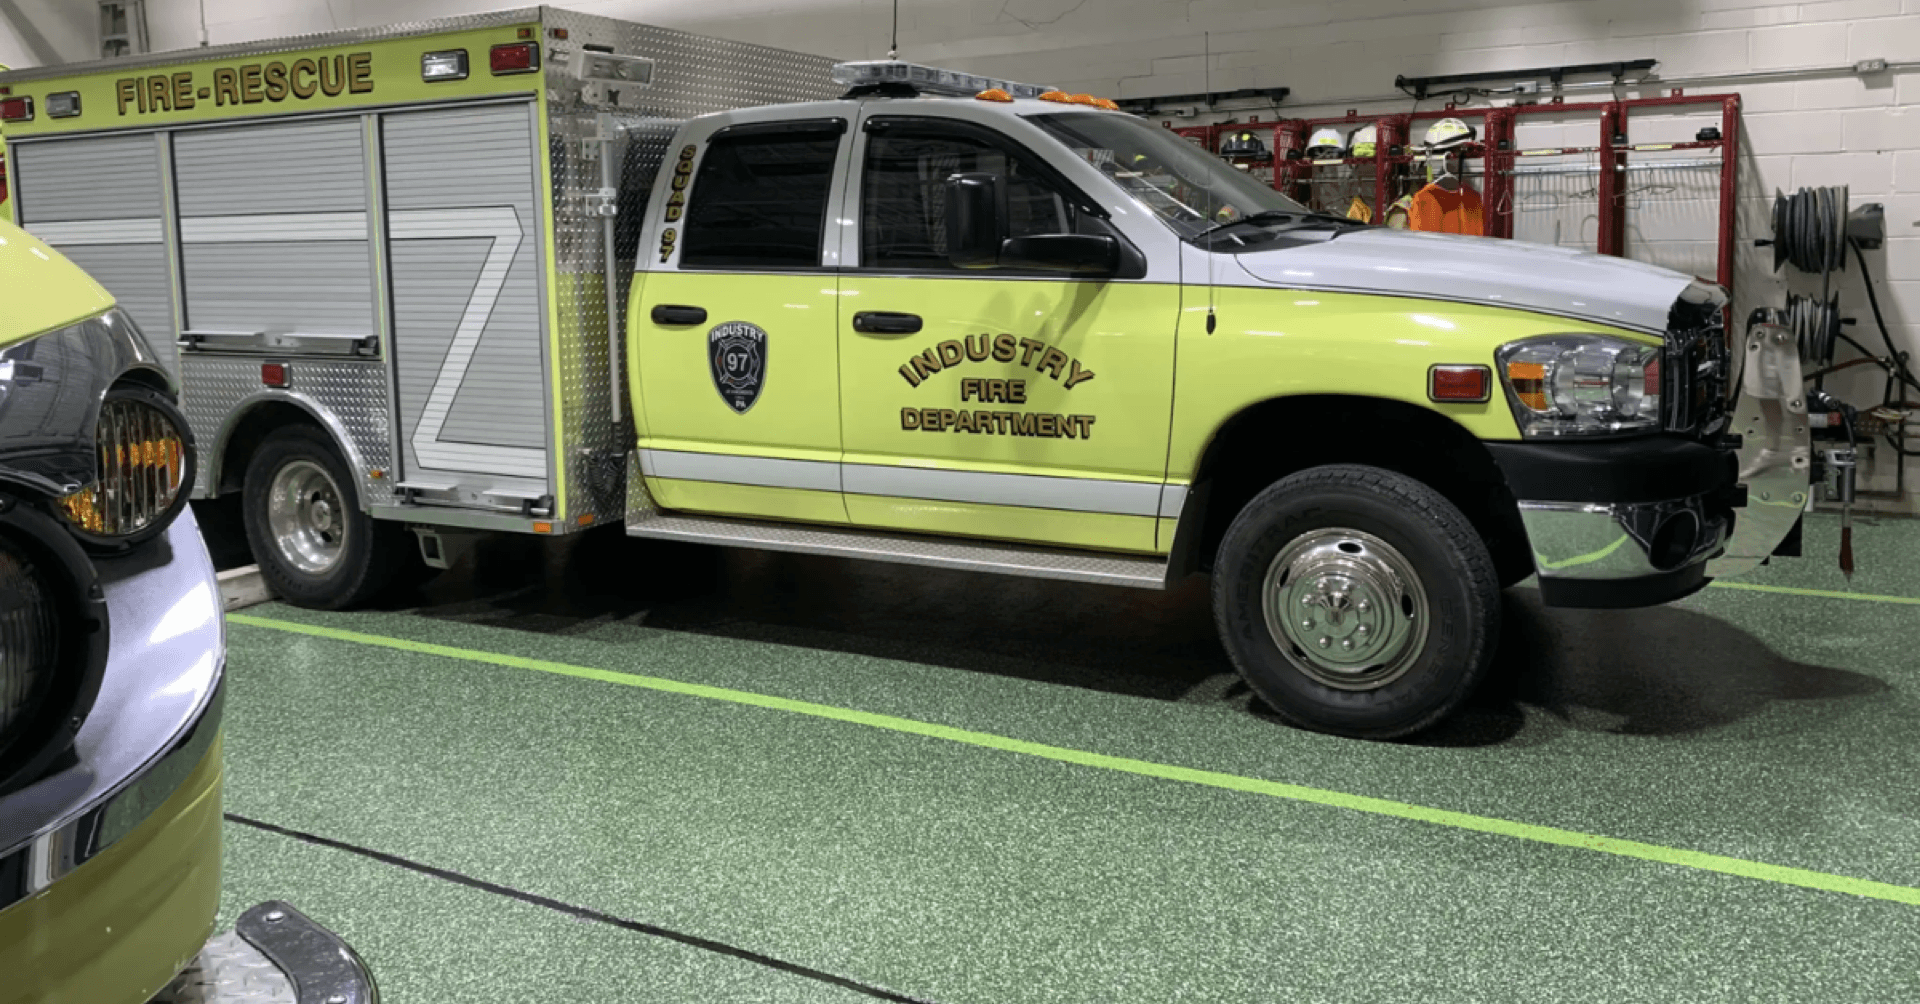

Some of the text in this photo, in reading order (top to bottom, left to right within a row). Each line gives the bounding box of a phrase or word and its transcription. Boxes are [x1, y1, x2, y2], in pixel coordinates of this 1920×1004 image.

[115, 52, 374, 115] FIRE-RESCUE
[659, 144, 697, 263] SQUAD 97
[711, 323, 763, 343] INDUSTRY
[727, 353, 748, 372] 97
[898, 333, 1096, 389] INDUSTRY
[961, 377, 1027, 404] FIRE
[901, 407, 1096, 440] DEPARTMENT
